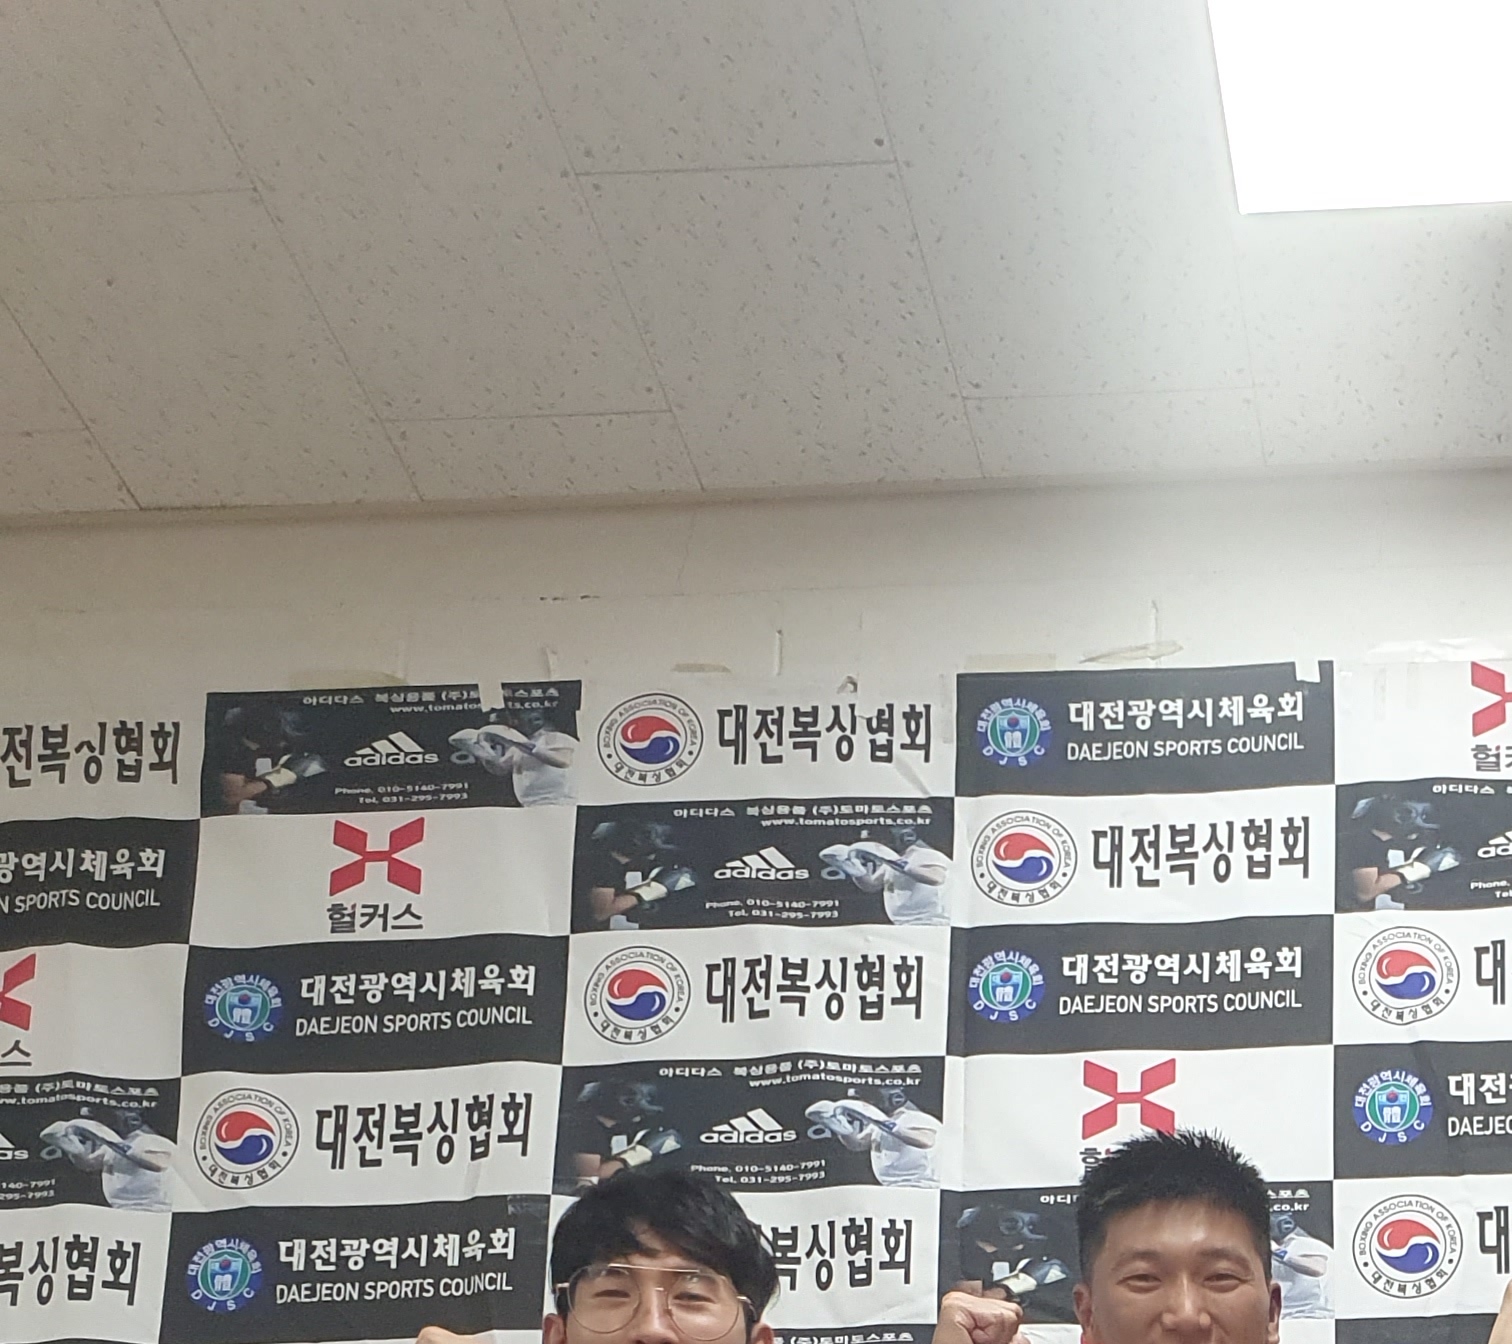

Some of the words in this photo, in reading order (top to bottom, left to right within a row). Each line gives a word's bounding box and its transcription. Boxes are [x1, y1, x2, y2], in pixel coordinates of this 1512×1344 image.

[1069, 691, 1304, 733] 대전광역시체육회
[345, 750, 439, 766] adidas
[1067, 738, 1148, 761] DAEJEON
[1153, 740, 1221, 757] SPORTS
[1226, 732, 1305, 752] COUNCIL
[1432, 783, 1495, 795] 아디다스
[673, 806, 735, 819] 아디다스
[761, 817, 931, 828] www.tomatosports.co.kr
[1092, 815, 1310, 890] 대전복싱협회
[714, 868, 809, 880] adidas
[15, 890, 80, 912] SPORTS
[85, 889, 160, 908] COUNCIL
[746, 898, 839, 909] 010-5140-7991
[327, 904, 424, 933] 헐커스
[752, 908, 838, 919] 031-295-7993
[1062, 947, 1302, 986] 대전광역시체육회
[300, 965, 536, 1006] 대전광역시체육회
[706, 953, 924, 1023] 대전복싱협회
[1059, 994, 1142, 1015] DAEJEON
[1147, 994, 1218, 1013] SPORTS
[1222, 989, 1302, 1010] COUNCIL
[296, 1015, 378, 1037] DAEJEON
[383, 1012, 452, 1033] SPORTS
[456, 1007, 533, 1028] COUNCIL
[659, 1065, 722, 1079] 아디다스
[749, 1076, 920, 1088] www.tomatosports.co.kr
[315, 1093, 533, 1171] 대전복싱협회
[700, 1128, 797, 1144] adidas
[735, 1159, 826, 1173] 010-5140-7991
[741, 1171, 826, 1184] 031-295-7993
[278, 1227, 516, 1271] 대전광역시체육회
[276, 1282, 358, 1304] DAEJEON
[363, 1278, 435, 1300] SPORTS
[439, 1271, 512, 1296] COUNCIL
